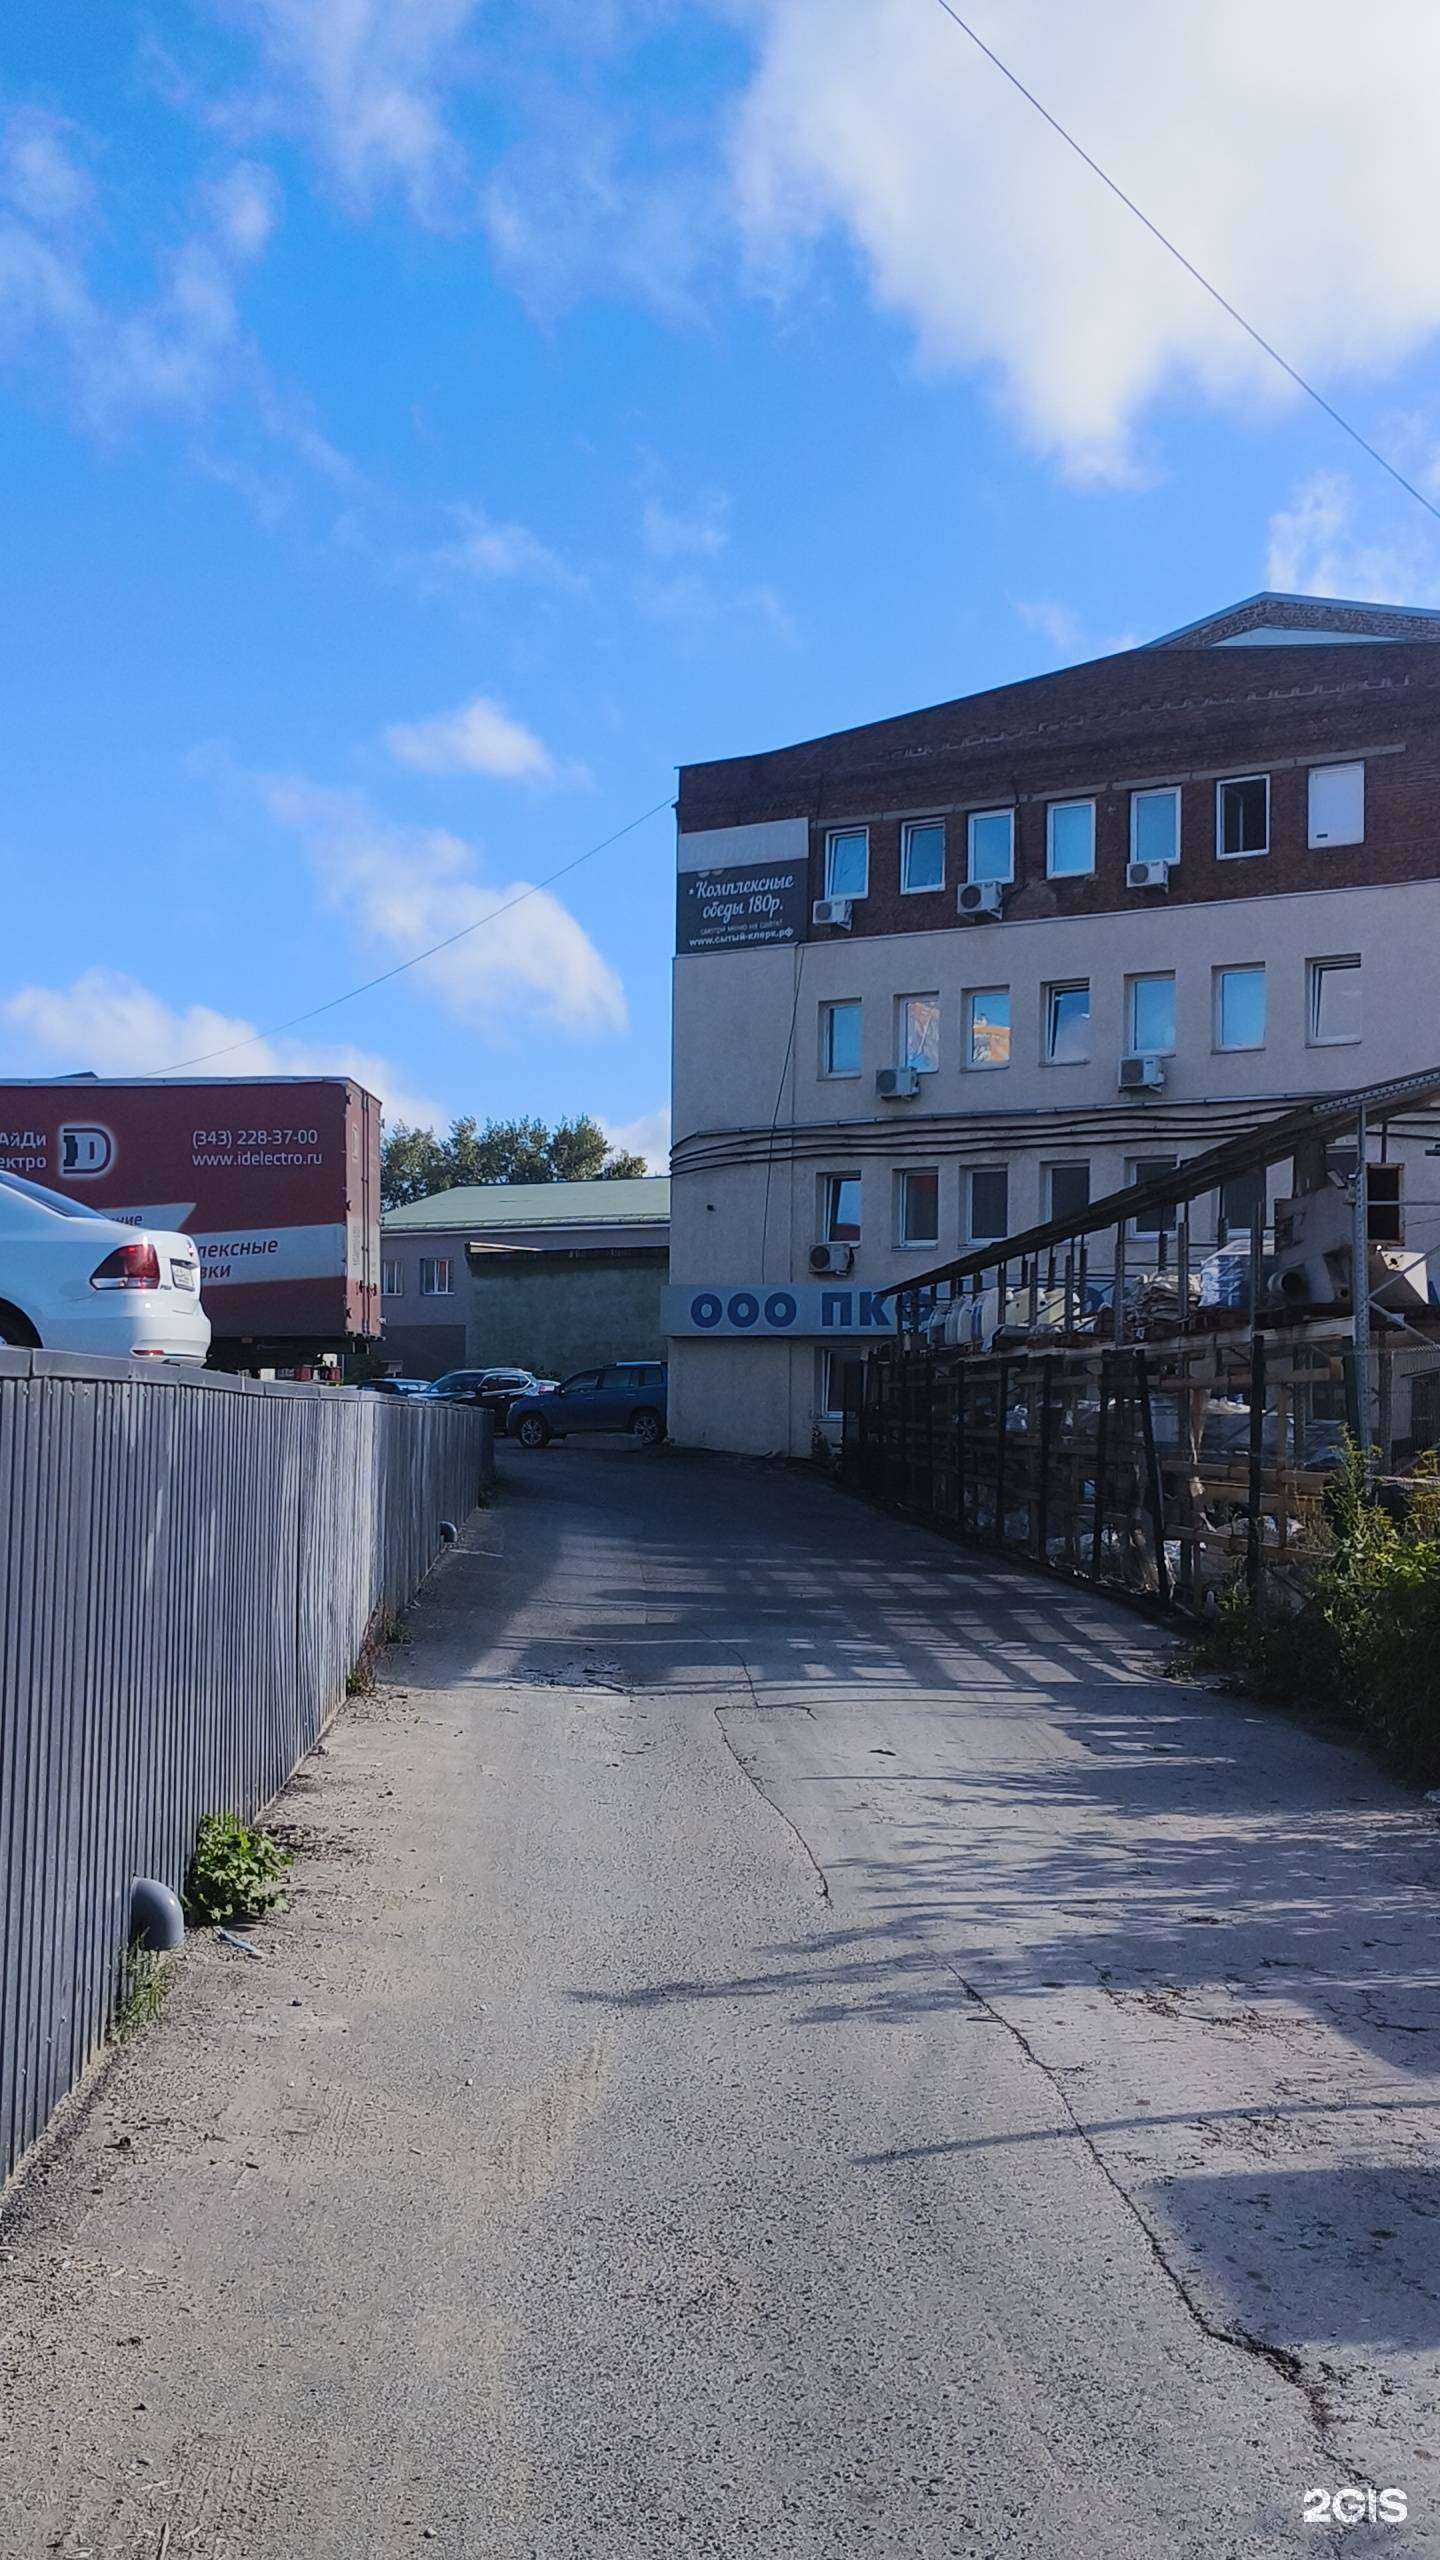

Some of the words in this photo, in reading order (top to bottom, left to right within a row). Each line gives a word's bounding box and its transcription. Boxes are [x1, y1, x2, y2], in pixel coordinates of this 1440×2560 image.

[696, 875, 794, 898] Комплексные
[702, 900, 745, 924] обеды
[747, 894, 783, 918] 180р.
[0, 1131, 47, 1149] АйДи
[192, 1130, 232, 1148] (343)
[237, 1129, 318, 1146] 228-37-00
[192, 1151, 322, 1166] www.idelectro.ru
[690, 1292, 797, 1328] ООО
